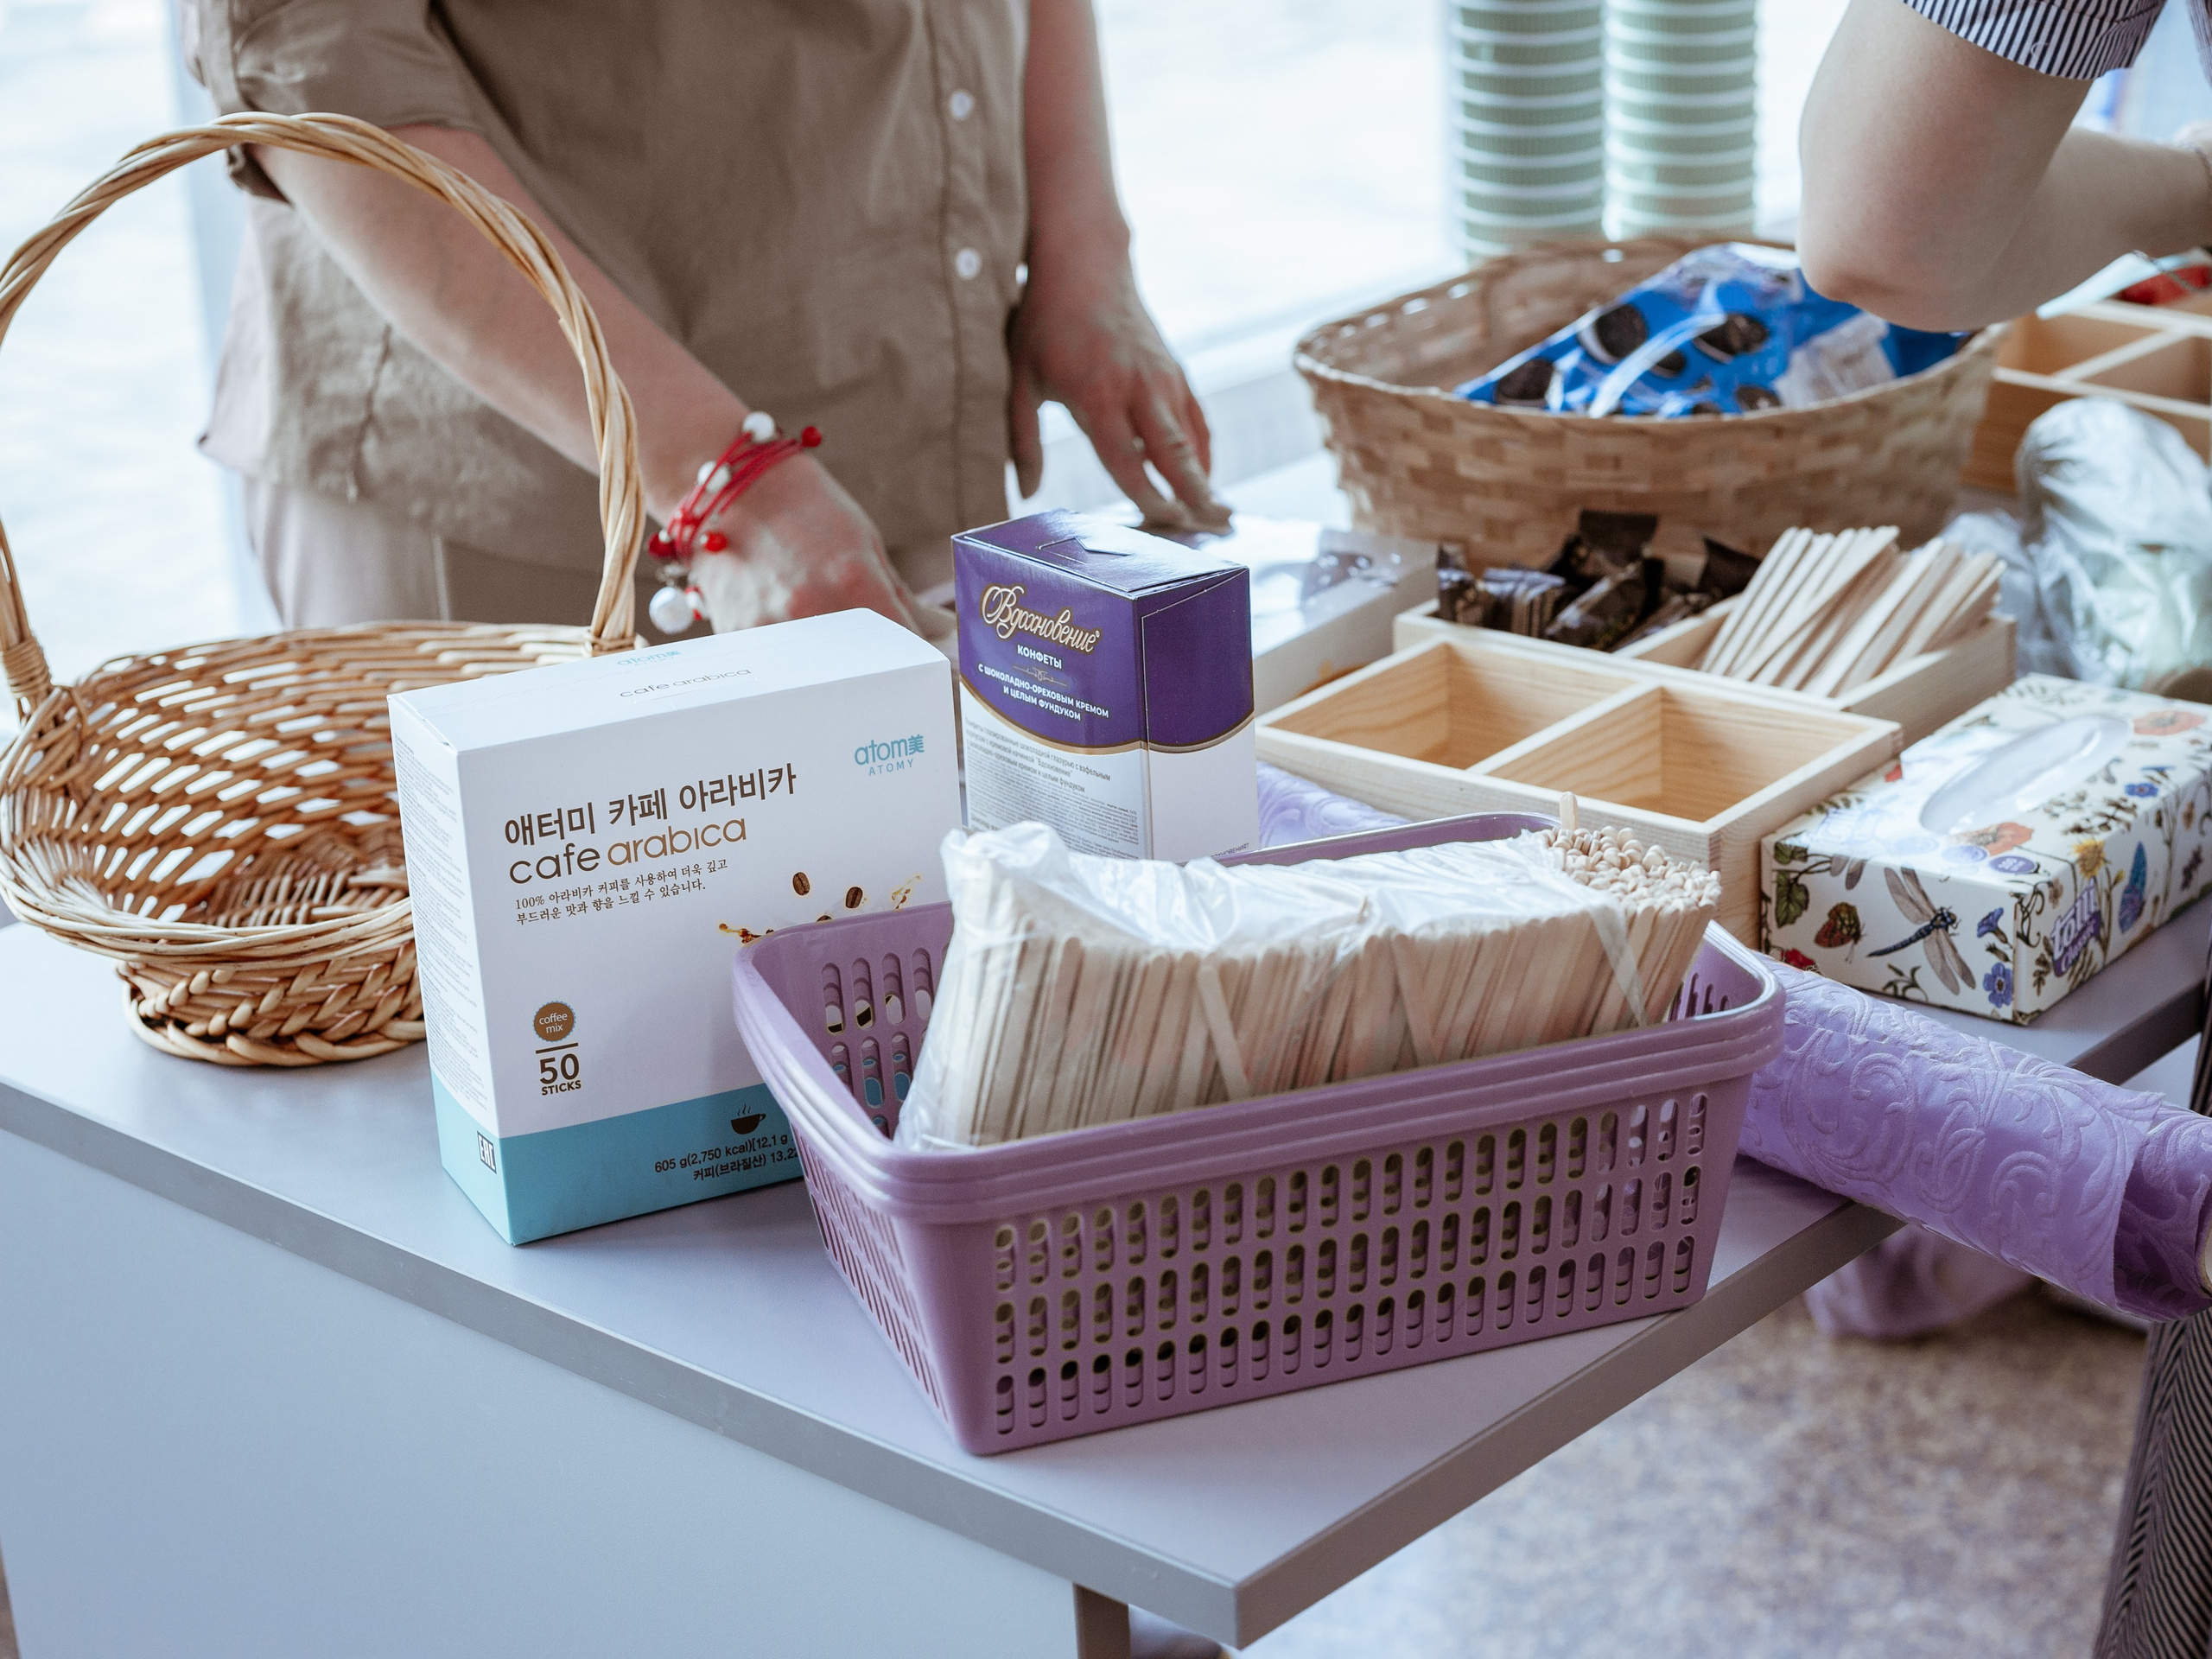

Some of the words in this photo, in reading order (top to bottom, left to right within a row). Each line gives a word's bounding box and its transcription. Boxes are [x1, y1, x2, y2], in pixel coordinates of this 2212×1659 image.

[982, 586, 1096, 652] Вдохновение
[1017, 645, 1062, 669] КОНФЕТЫ
[620, 683, 670, 697] cafe
[672, 669, 751, 687] arabica
[978, 664, 984, 672] С
[984, 665, 1074, 706] ШОКОЛАДНО-ОРЕХОВЫМ
[1076, 699, 1109, 718] КРЕМОМ
[1003, 685, 1009, 694] И
[1011, 688, 1037, 705] ЦЕЛЫМ
[1039, 699, 1081, 721] ФУНДУКОМ
[868, 759, 913, 777] ATOMY
[1051, 754, 1074, 768] глазурью
[1079, 765, 1110, 781] вафельным
[505, 802, 596, 846] 애터미
[608, 788, 668, 826] 카페
[679, 762, 797, 812] 아라비카
[509, 842, 601, 885] cafe
[607, 817, 747, 866] arabica
[516, 894, 545, 910] 100%
[549, 885, 594, 904] 아라비카
[598, 877, 631, 894] 커피를
[634, 867, 678, 887] 사용하여
[681, 864, 702, 878] 더욱
[707, 859, 728, 874] 깊고
[516, 907, 562, 925] 부드러운
[566, 902, 588, 918] 맛과
[593, 897, 614, 912] 향을
[619, 890, 640, 906] 느낄
[645, 888, 655, 899] 수
[659, 878, 706, 899] 있습니다.
[539, 1012, 568, 1026] coffee
[545, 1023, 563, 1033] mix
[540, 1053, 580, 1084] 50
[541, 1080, 582, 1096] STICKS
[654, 1158, 677, 1173] 605
[679, 1147, 721, 1169] g(2,750
[725, 1135, 778, 1157] kcal)[12.1
[780, 1135, 788, 1145] g
[693, 1154, 766, 1181] 커피(브라질산)
